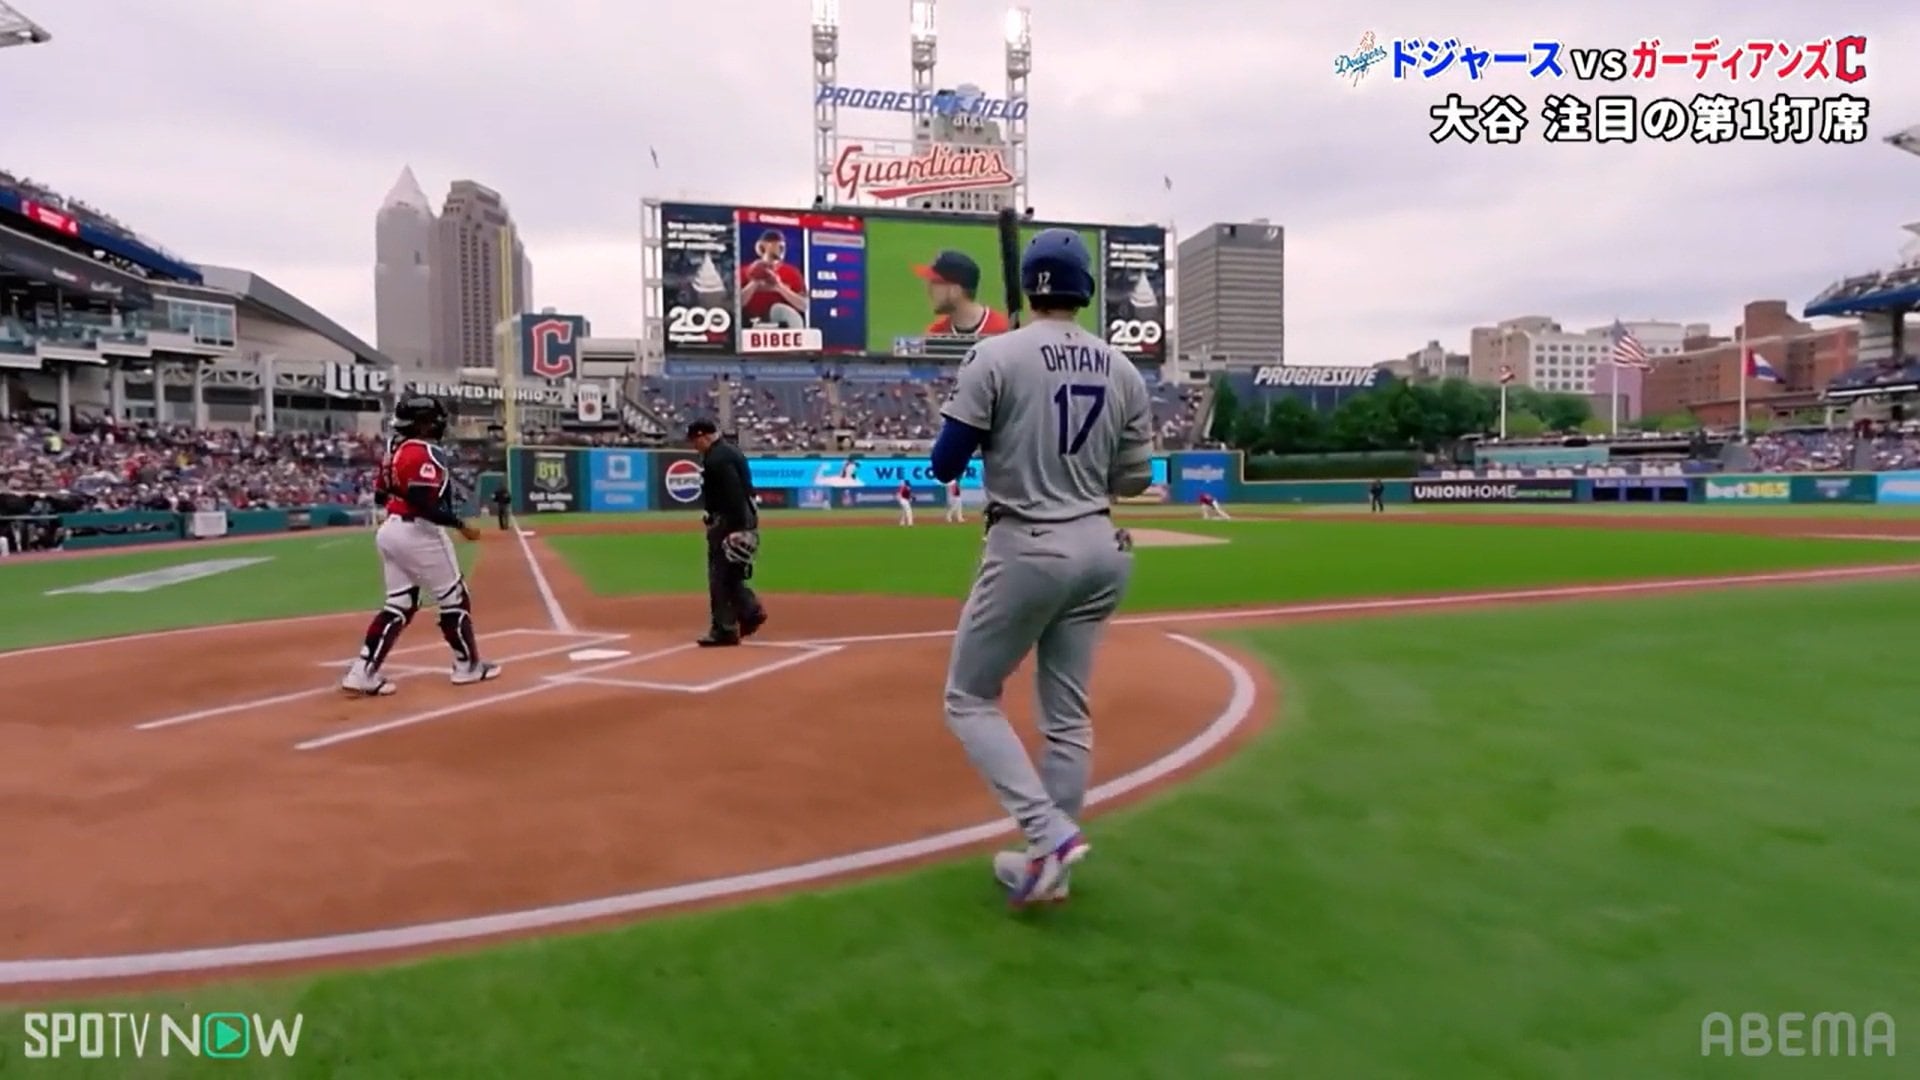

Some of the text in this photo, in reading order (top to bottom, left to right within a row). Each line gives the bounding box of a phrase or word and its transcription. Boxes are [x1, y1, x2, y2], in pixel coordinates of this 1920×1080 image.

[836, 145, 1012, 199] Guardians
[669, 306, 731, 334] 200
[1110, 319, 1161, 344] 200
[532, 319, 573, 378] C
[751, 333, 803, 347] BIBEE
[1041, 344, 1110, 377] OHTANI
[323, 360, 386, 398] Lite
[1254, 366, 1377, 386] PROGRESSIVE
[416, 383, 484, 399] BREWED
[1054, 384, 1105, 456] 17
[875, 467, 904, 480] WE
